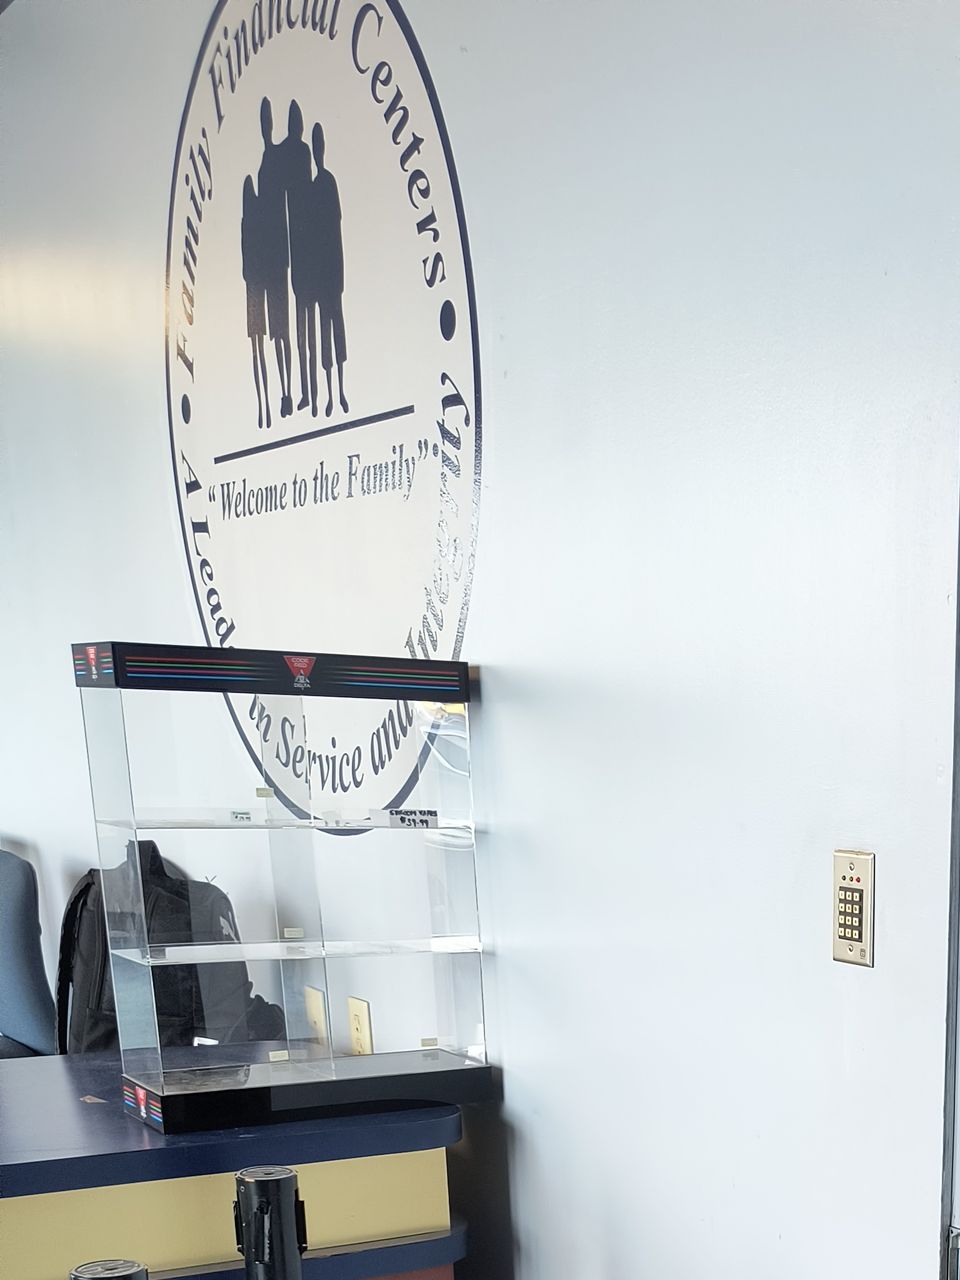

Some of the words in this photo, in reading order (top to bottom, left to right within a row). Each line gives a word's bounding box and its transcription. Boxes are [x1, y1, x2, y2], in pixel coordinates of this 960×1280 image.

[176, 127, 212, 383] Family
[351, 2, 447, 289] Centers
[181, 450, 203, 499] A
[292, 473, 308, 508] to
[312, 461, 340, 505] the
[190, 515, 236, 648] Lead
[275, 716, 365, 794] Service
